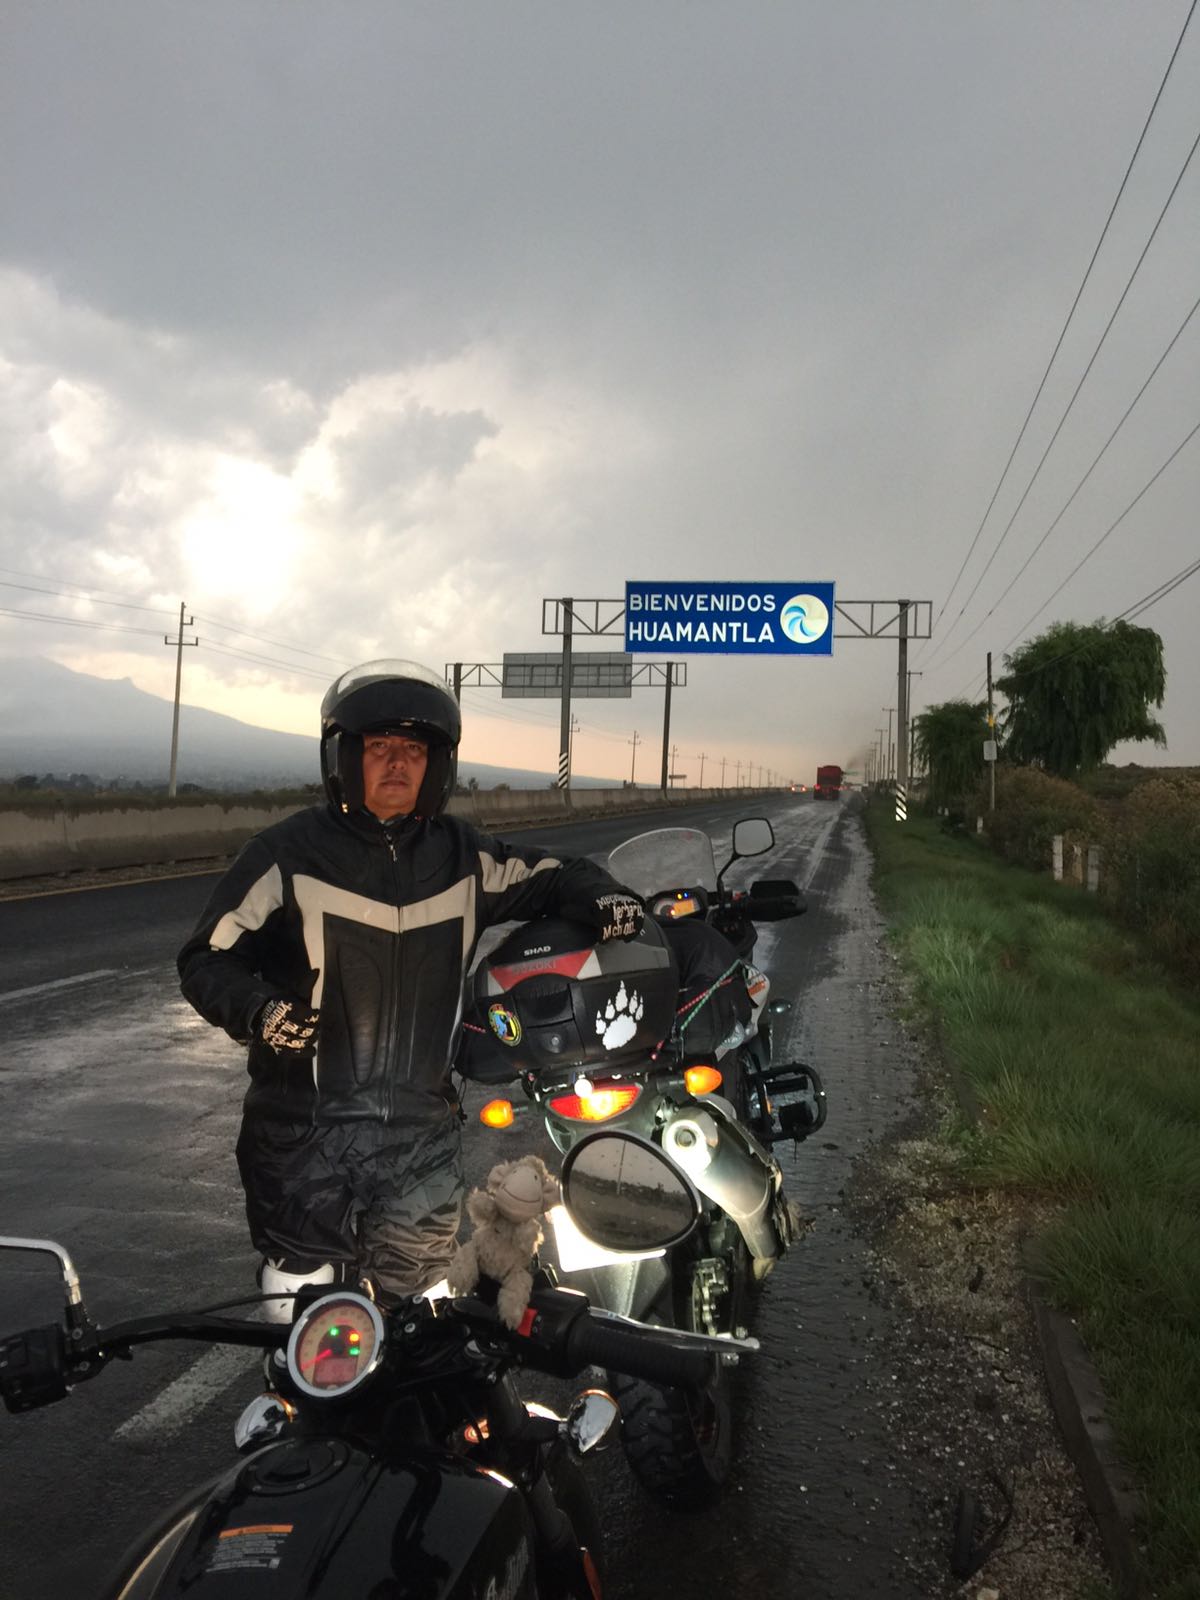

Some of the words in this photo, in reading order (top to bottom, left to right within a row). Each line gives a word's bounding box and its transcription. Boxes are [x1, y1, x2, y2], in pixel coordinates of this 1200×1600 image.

[629, 594, 776, 612] BIENVENIDOS
[629, 622, 775, 643] HUAMANTLA
[524, 946, 551, 956] SHAD
